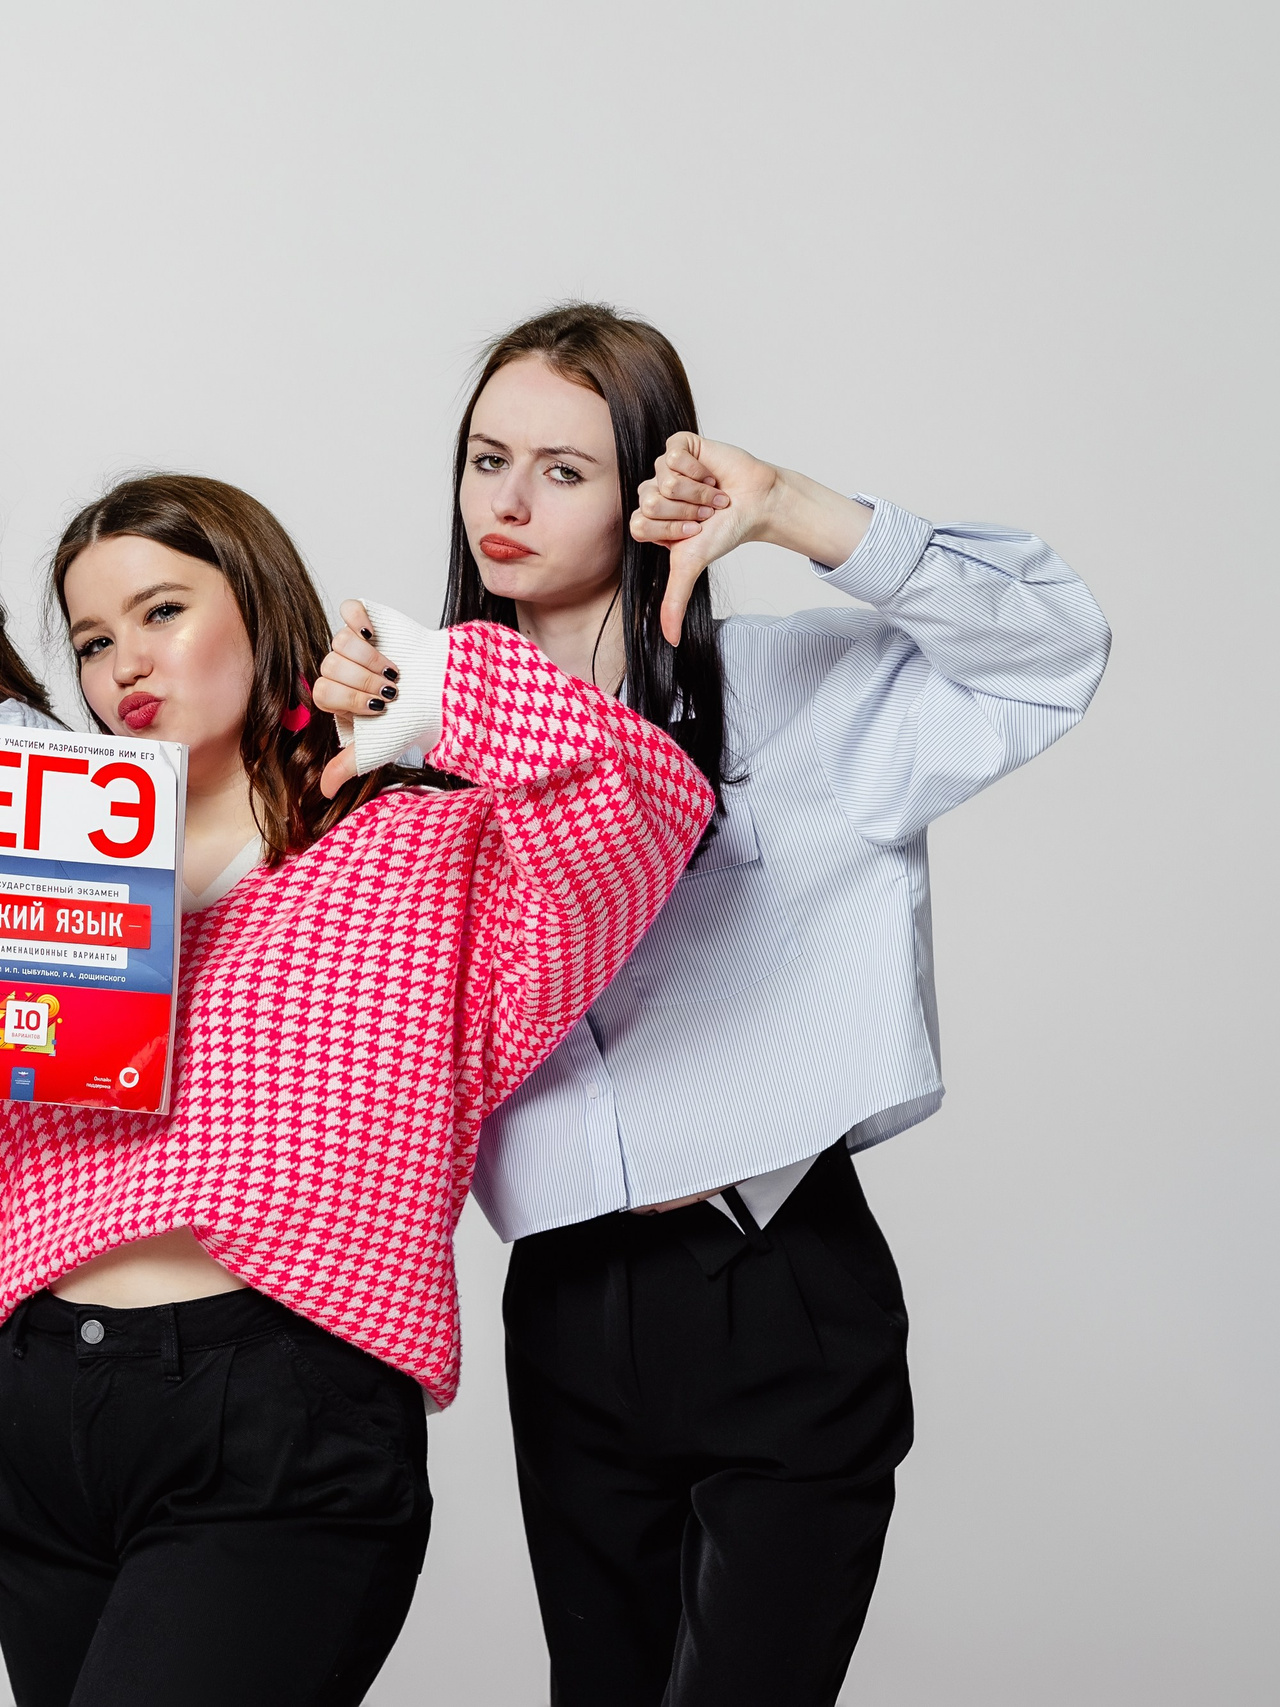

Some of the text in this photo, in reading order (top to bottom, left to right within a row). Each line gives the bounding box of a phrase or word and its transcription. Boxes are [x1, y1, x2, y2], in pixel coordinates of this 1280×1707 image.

[5, 738, 45, 750] УЧАСТИЕМ
[49, 743, 115, 757] РАЗРАБОТЧИКОВ
[118, 750, 137, 759] КИМ
[140, 752, 155, 761] ЕГЭ
[77, 887, 120, 898] ЭКЗАМЕН
[55, 908, 124, 938] ЯЗЫК
[73, 951, 117, 962] ВАРИАНТЫ
[22, 968, 61, 977] ЦЫБУЛЬКО,
[79, 972, 126, 983] ДОЩИНСКОГО
[14, 1009, 41, 1031] 10
[11, 1032, 40, 1040] ВАРИАНТОВ
